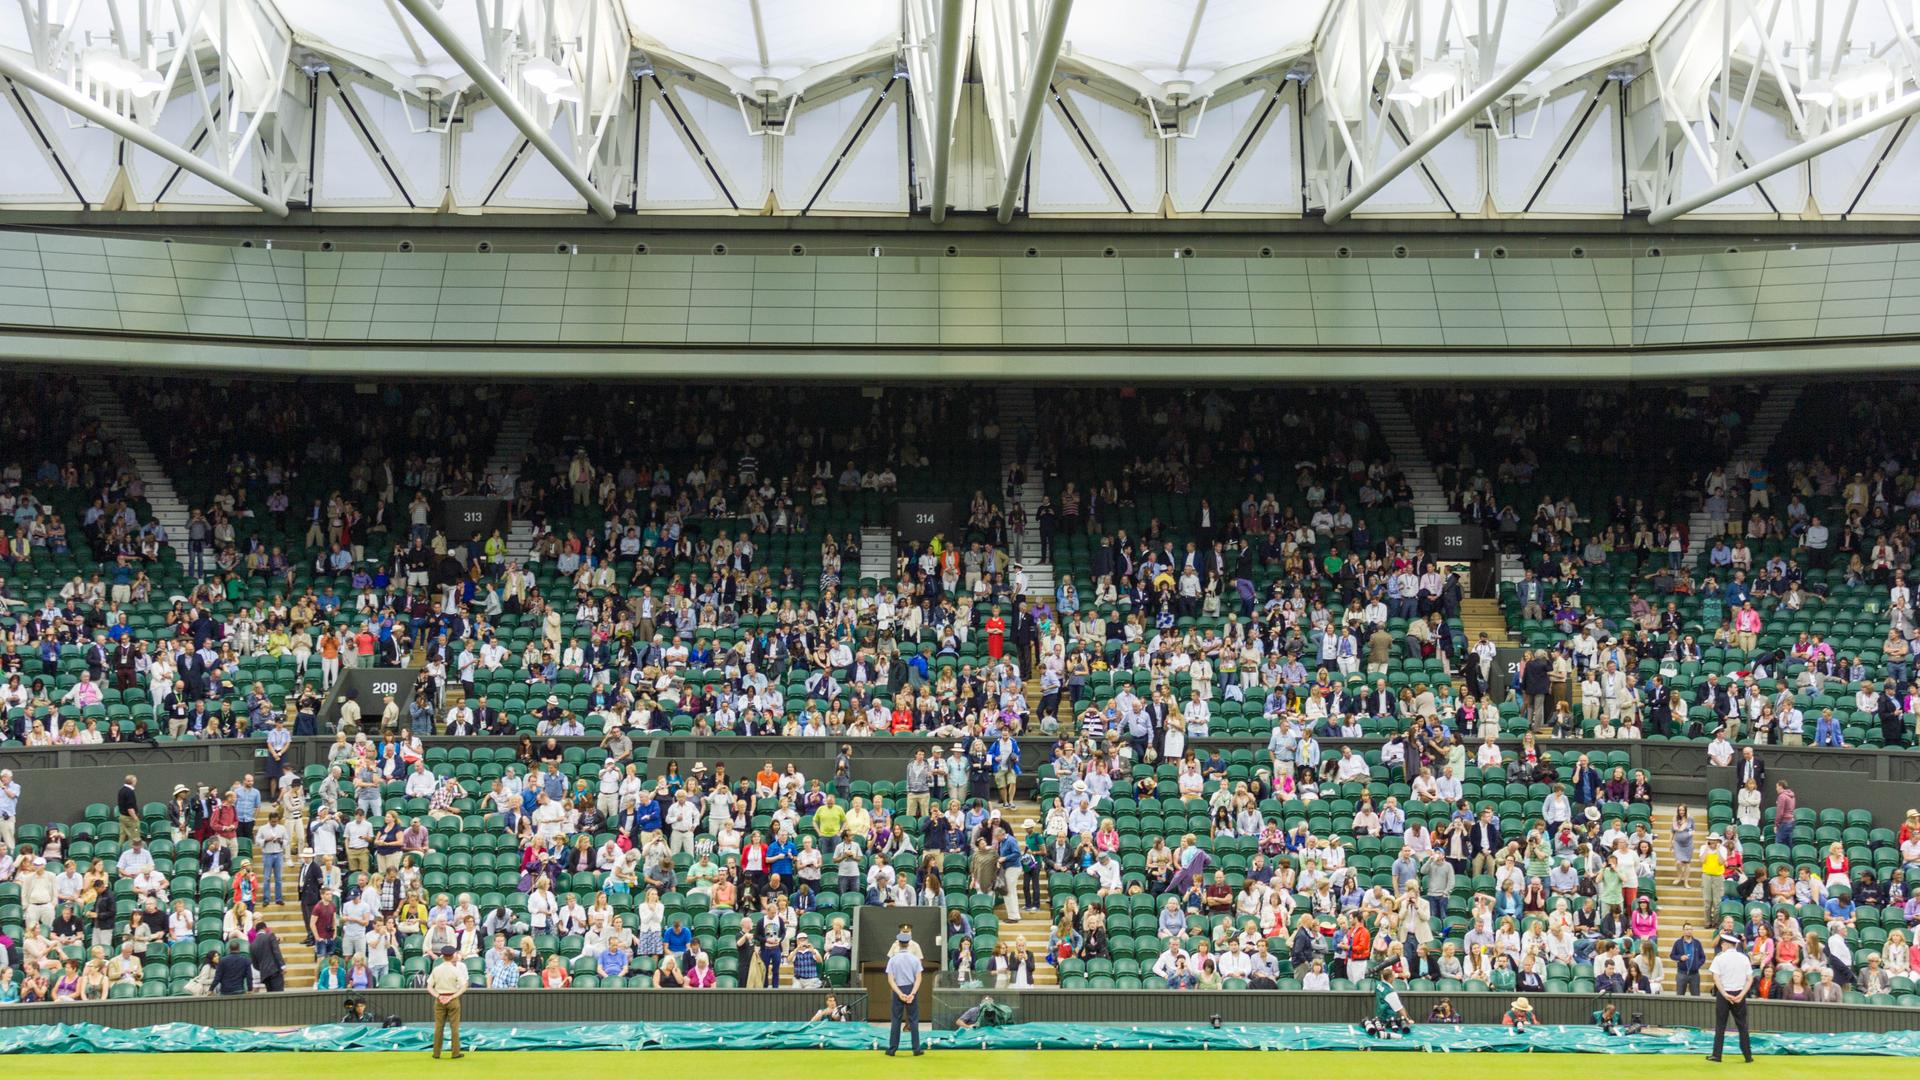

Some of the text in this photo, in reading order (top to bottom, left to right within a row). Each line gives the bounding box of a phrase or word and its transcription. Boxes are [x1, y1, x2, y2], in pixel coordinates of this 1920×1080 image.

[463, 512, 482, 522] 313
[916, 514, 935, 524] 314
[1444, 536, 1463, 546] 315
[1508, 662, 1520, 673] 21
[372, 682, 398, 694] 209
